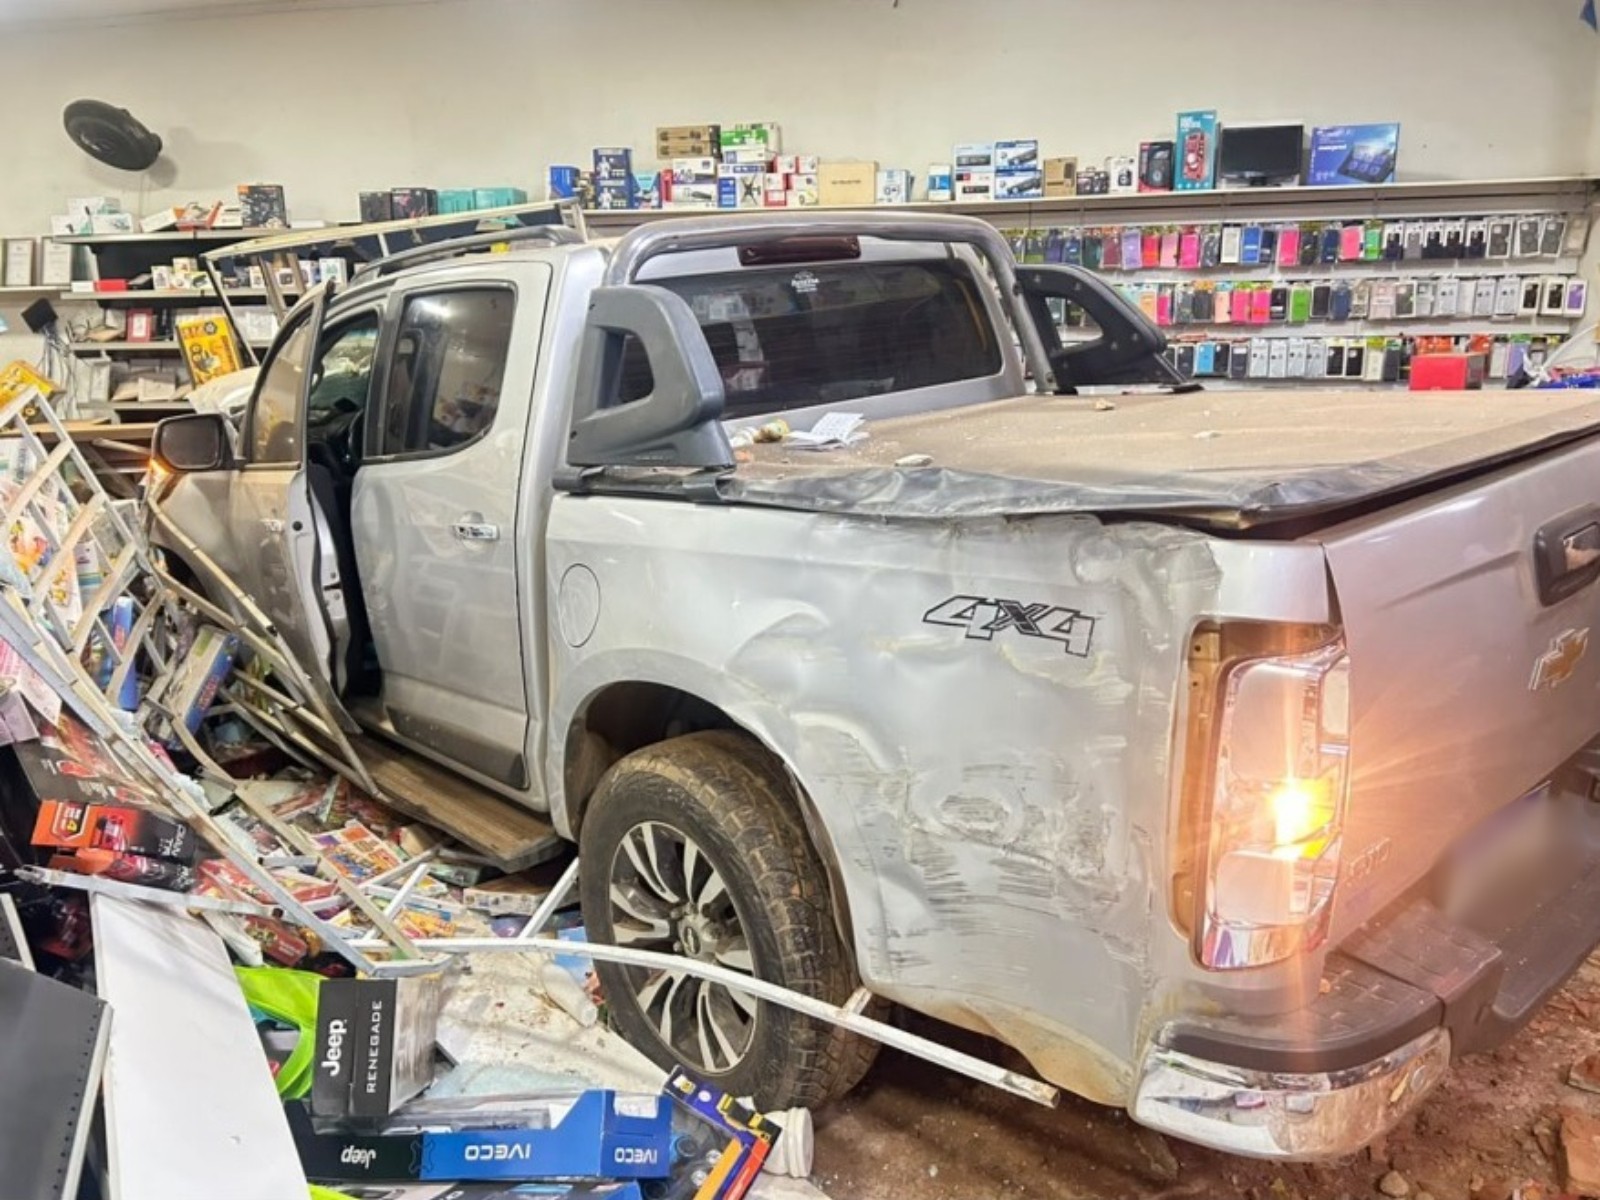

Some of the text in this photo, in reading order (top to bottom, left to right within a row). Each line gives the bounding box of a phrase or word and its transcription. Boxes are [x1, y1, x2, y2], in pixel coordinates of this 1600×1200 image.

[321, 1018, 348, 1077] Jeep
[366, 1000, 383, 1093] RENEGADE
[340, 1144, 377, 1170] Jeep
[464, 1143, 532, 1161] IVECO
[614, 1147, 658, 1165] IVECO
